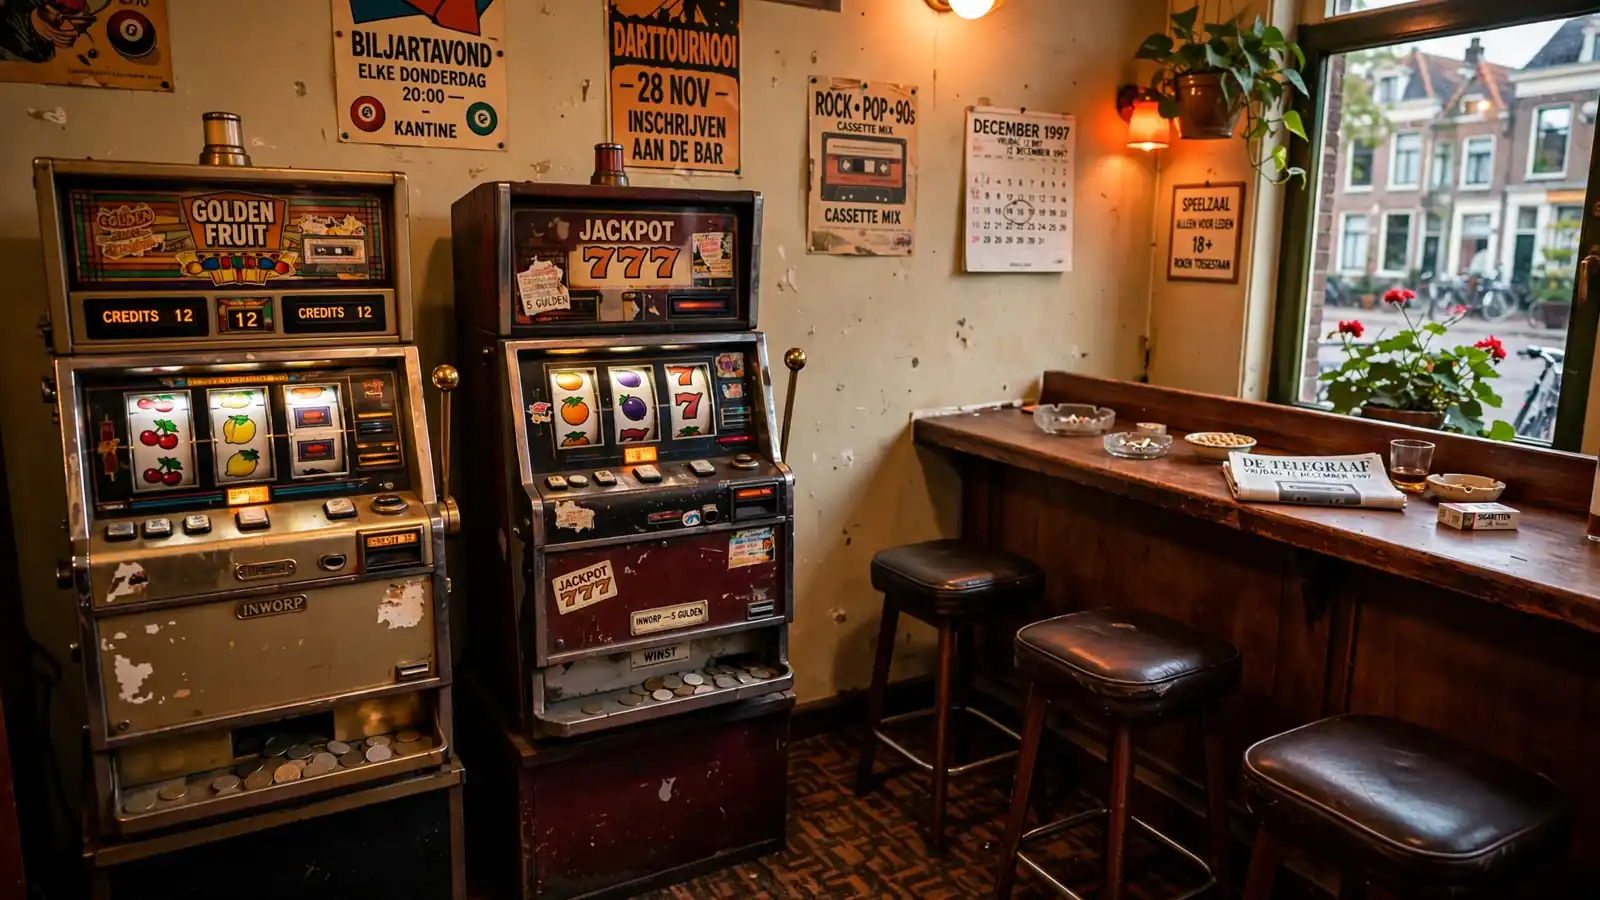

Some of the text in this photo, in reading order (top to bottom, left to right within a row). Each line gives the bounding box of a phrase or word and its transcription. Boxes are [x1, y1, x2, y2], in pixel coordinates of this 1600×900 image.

[352, 30, 492, 68] BILJARTAVOND
[613, 21, 737, 69] DARTTOURNOOI
[358, 63, 486, 88] ELKE DONDERDAG
[402, 86, 445, 104] 20:00
[637, 71, 710, 108] 28 NOV
[815, 91, 915, 125] ROCK POP 90s
[394, 120, 457, 138] KANTINE
[628, 110, 726, 138] INSCHRIJVEN
[837, 121, 893, 135] CASSETTE MIX
[973, 118, 1070, 140] DECEMBER 1997
[632, 137, 724, 165] AAN DE BAR
[192, 199, 275, 224] GOLDEN
[1182, 196, 1231, 212] SPEELZAAL
[824, 207, 902, 225] CASSETTE MIX
[205, 223, 267, 246] FRUIT
[579, 218, 675, 242] JACKPOT
[1192, 235, 1213, 253] 18+
[526, 295, 568, 310] 5 GULDEN
[102, 308, 193, 323] CREDITS 12
[236, 311, 258, 328] 12
[298, 306, 372, 319] CREDITS 12
[1243, 457, 1371, 473] DE TELEGRAAF
[1243, 467, 1282, 476] VRIJDAG
[558, 565, 608, 591] JACKPOT
[243, 597, 303, 616] INWORP
[635, 614, 662, 626] INWORP
[671, 611, 676, 620] 5
[677, 607, 703, 619] GULDEN
[643, 646, 677, 662] WINST
